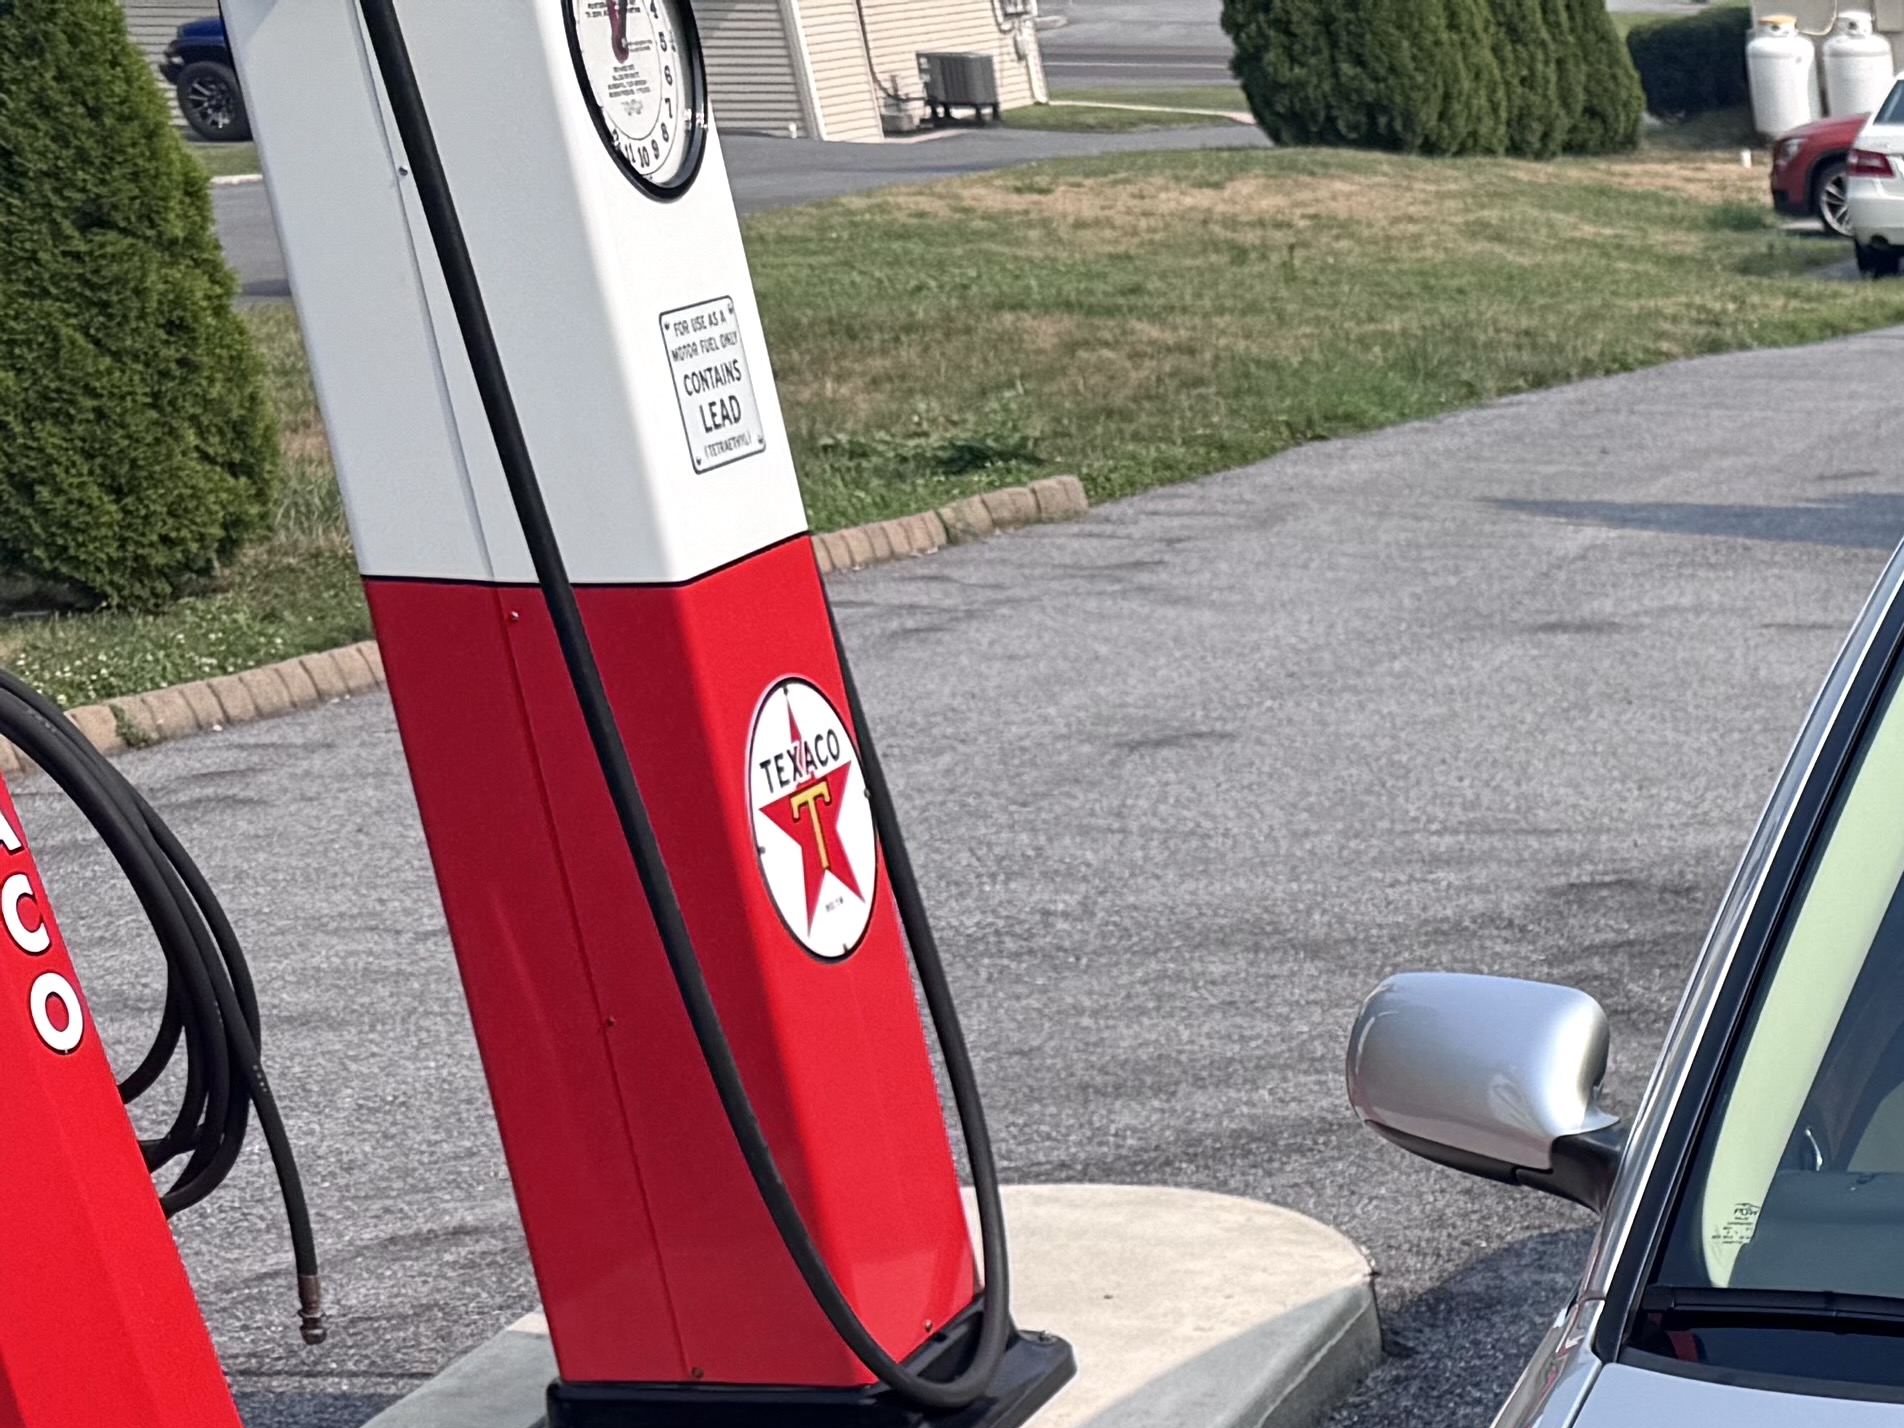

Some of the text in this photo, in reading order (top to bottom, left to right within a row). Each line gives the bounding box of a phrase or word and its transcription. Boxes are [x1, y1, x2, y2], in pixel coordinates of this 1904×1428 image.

[658, 31, 667, 52] 5
[664, 65, 673, 86] 6
[664, 97, 673, 119] 7
[660, 122, 669, 143] 8
[637, 146, 650, 168] 10
[651, 139, 660, 160] 9
[673, 309, 727, 337] FOR USE AS A
[671, 331, 738, 362] MOTOR FUEL ONLY
[683, 358, 742, 396] CONTAINS
[699, 395, 742, 434] LEAD
[759, 728, 841, 794] TEXACO
[790, 780, 831, 871] T
